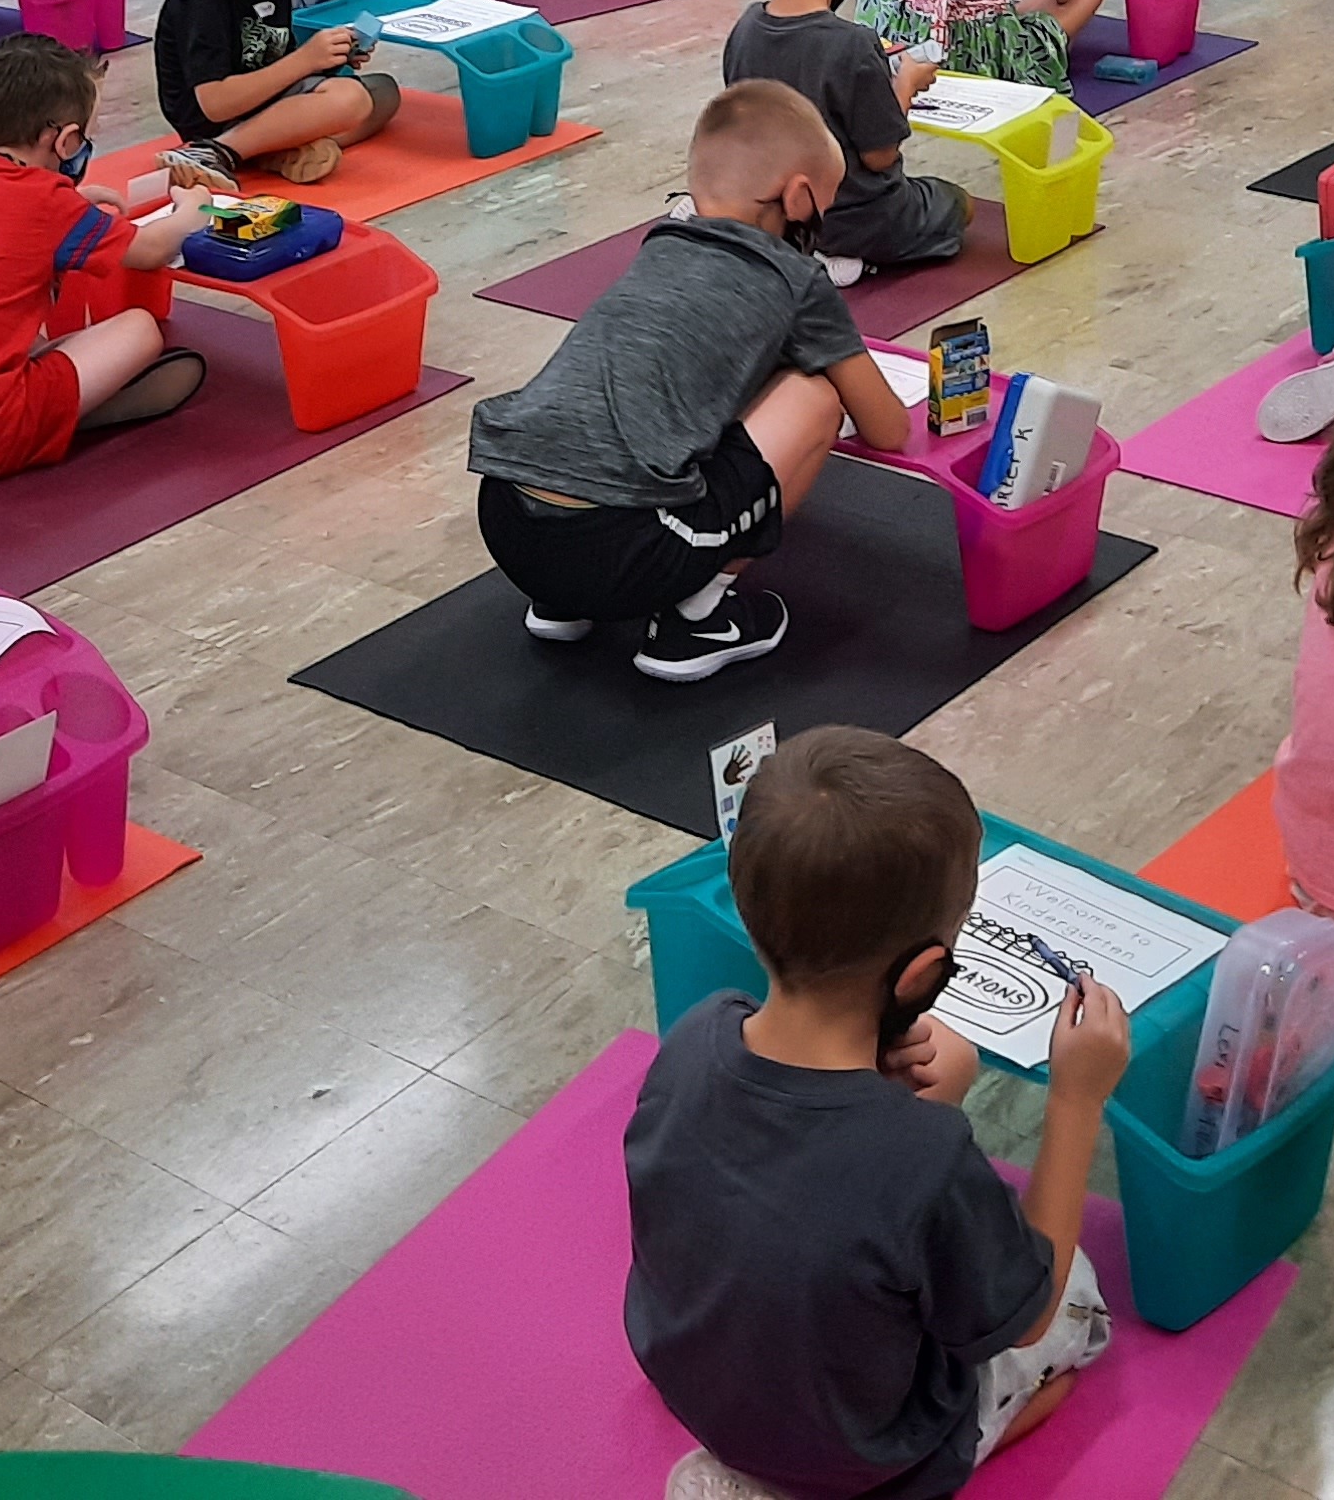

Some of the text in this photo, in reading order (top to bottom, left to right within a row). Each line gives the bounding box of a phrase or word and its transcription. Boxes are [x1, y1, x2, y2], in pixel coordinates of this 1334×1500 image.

[1014, 428, 1033, 441] K
[1002, 892, 1136, 961] Kindergarten
[1025, 881, 1151, 947] Welcome to
[955, 964, 1029, 1005] RAYONS
